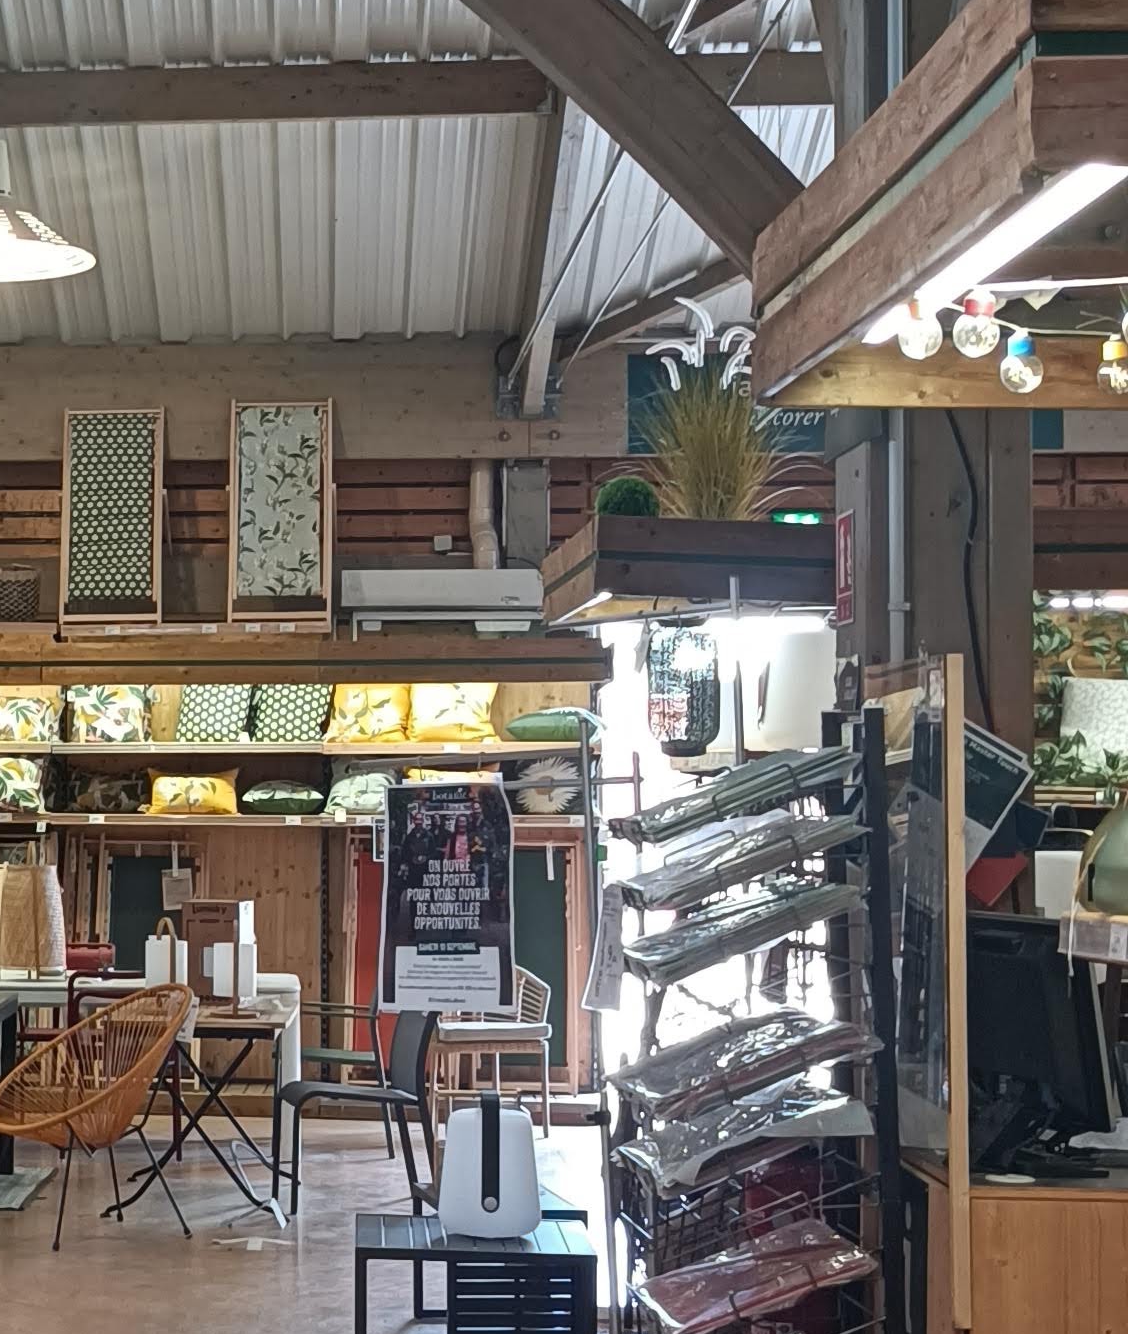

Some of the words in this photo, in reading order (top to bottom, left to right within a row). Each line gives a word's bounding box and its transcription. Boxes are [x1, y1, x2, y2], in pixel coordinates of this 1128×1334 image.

[428, 859, 441, 873] ON
[422, 873, 441, 887] NOS
[442, 873, 476, 887] PORTES
[406, 888, 431, 901] POUR
[433, 887, 457, 901] VOUS
[458, 887, 490, 901] OUVRIR
[416, 901, 429, 916] DE
[430, 901, 481, 916] NOUVELLES
